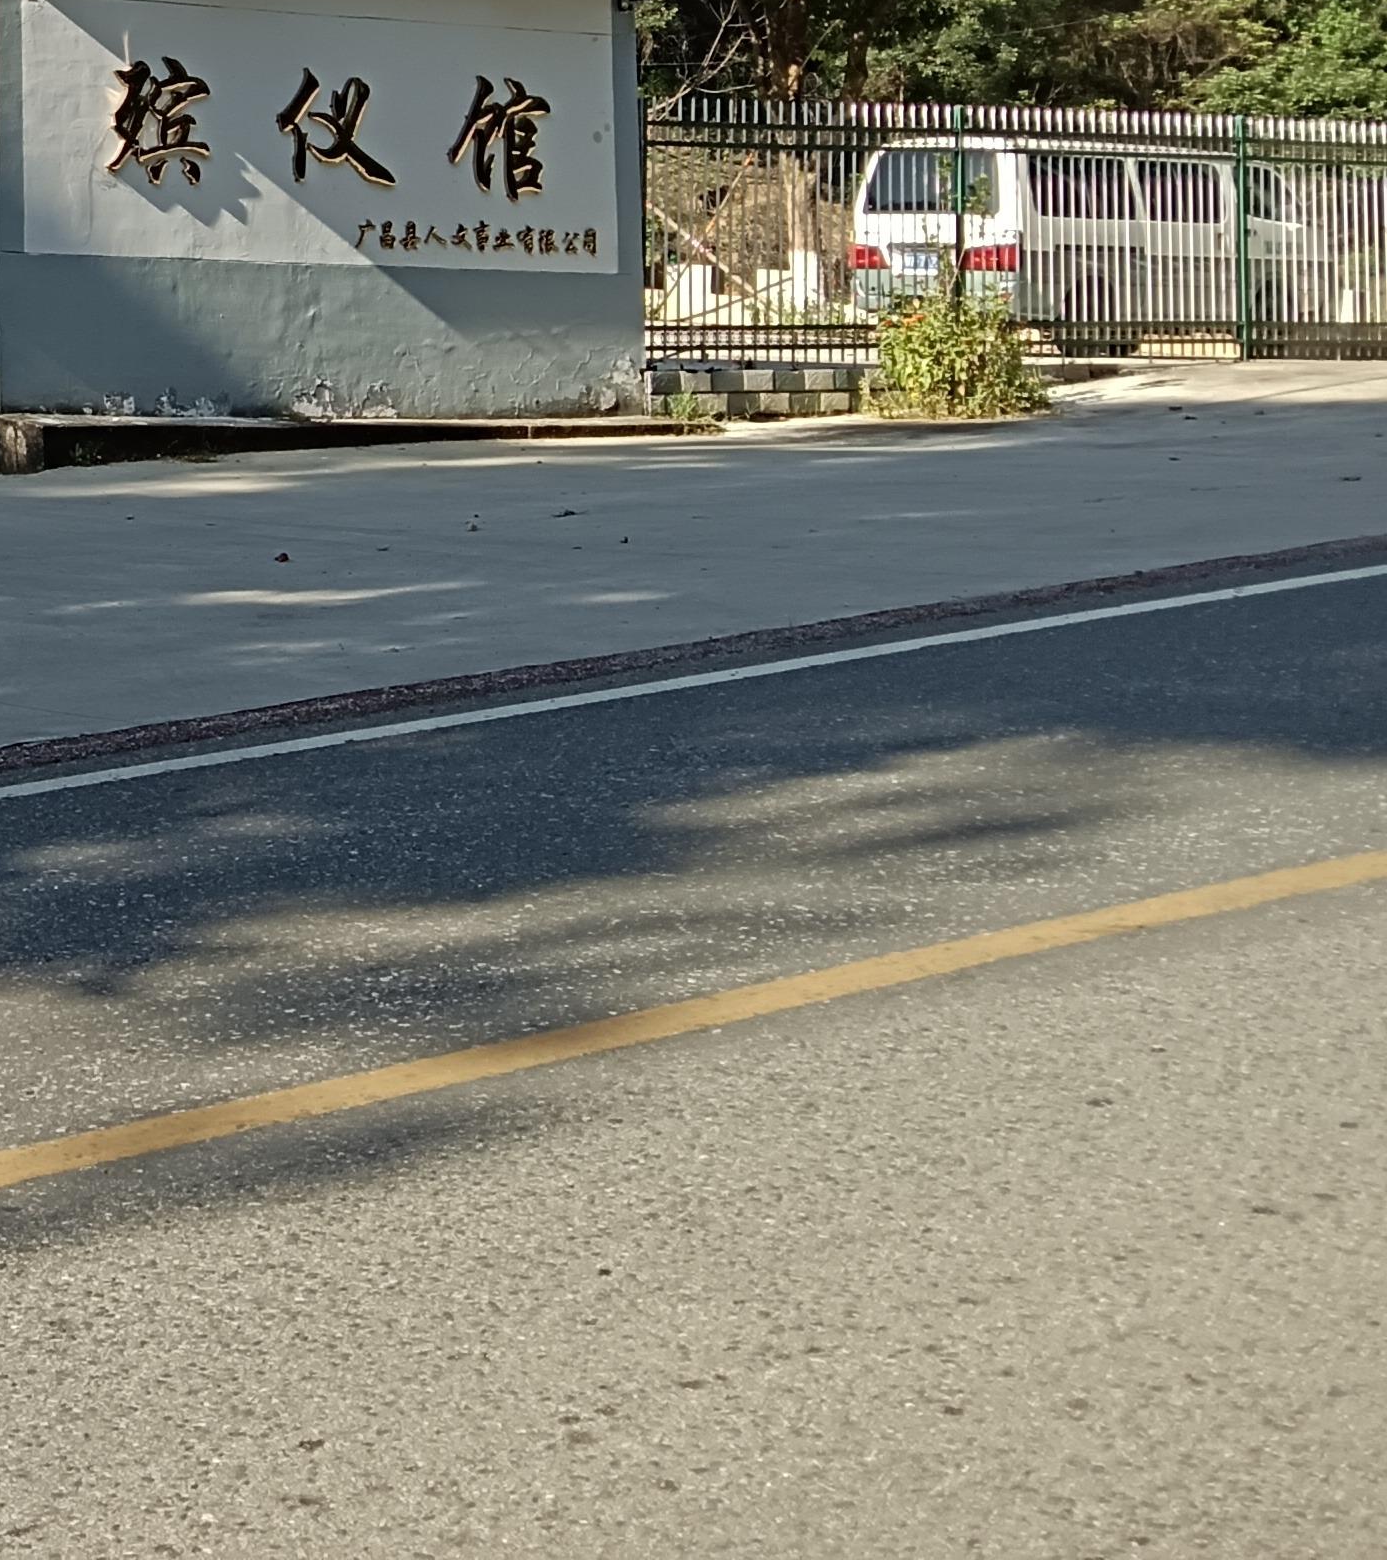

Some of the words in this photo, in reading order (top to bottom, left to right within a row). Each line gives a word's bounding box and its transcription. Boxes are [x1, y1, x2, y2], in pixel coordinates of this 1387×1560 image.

[105, 56, 552, 201] 殡仪馆
[354, 219, 599, 258] 广昌县人文事业有限公司
